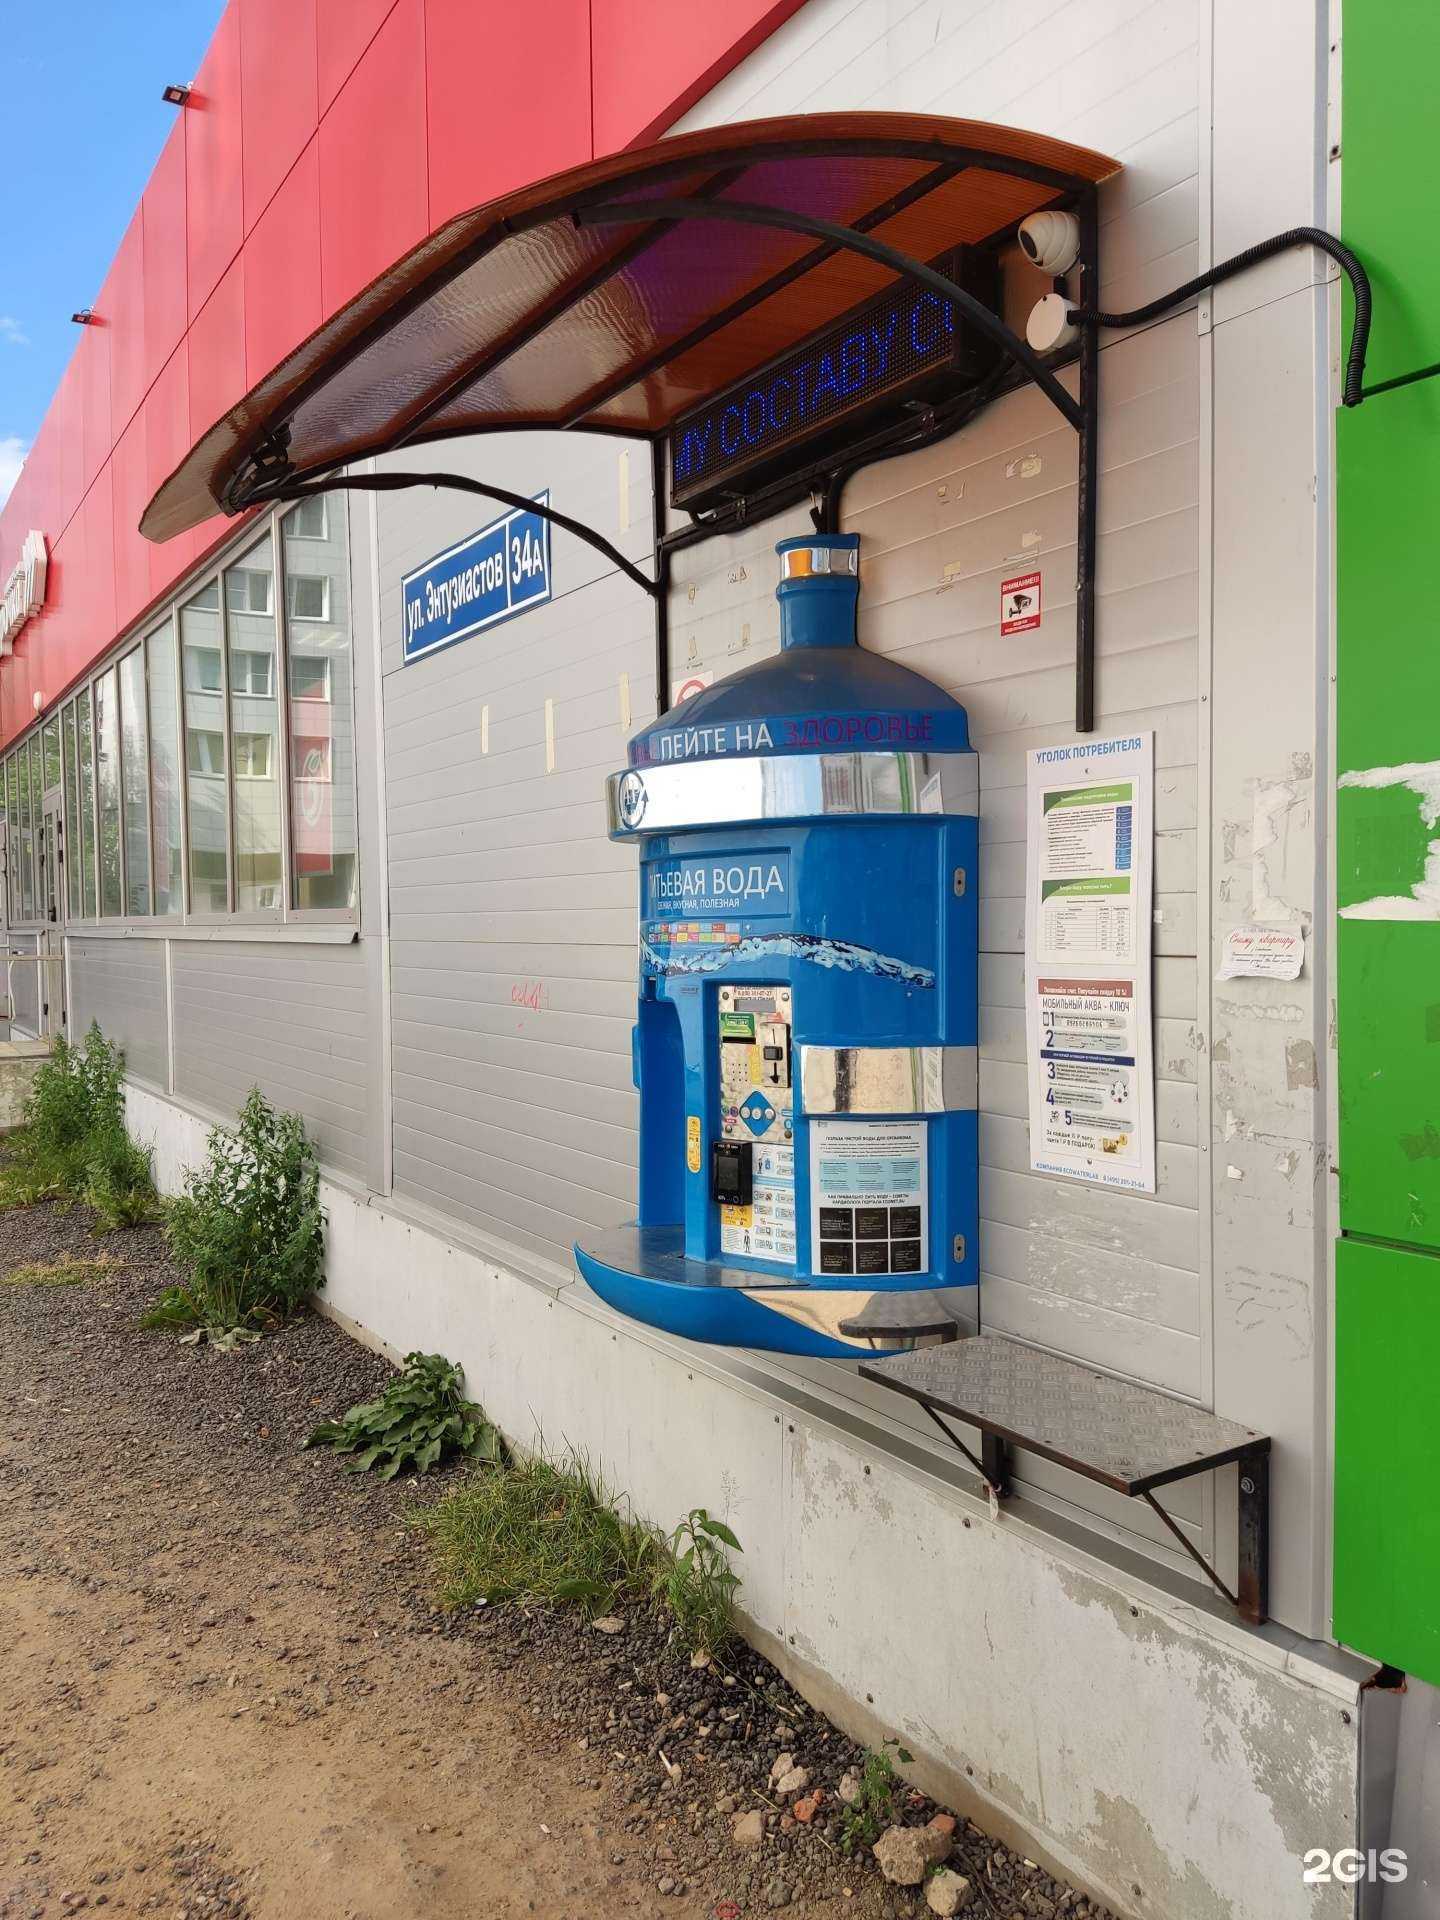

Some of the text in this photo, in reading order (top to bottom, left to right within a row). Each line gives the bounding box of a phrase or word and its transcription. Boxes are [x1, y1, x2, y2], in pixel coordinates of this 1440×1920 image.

[720, 311, 897, 457] СОСТАВУ
[407, 528, 544, 644] ул. Энтузиастов 34А
[660, 726, 727, 761] ПЕЙТЕ
[735, 722, 774, 751] НА
[783, 714, 935, 747] ЗДОРОВЬЕ
[1035, 737, 1142, 764] УГОЛОК ПОТРЕБИТЕЛЯ
[712, 864, 785, 900] ВОДА
[700, 898, 740, 909] ПОЛЕЗНАЯ
[1042, 997, 1083, 1009] МОБИЛЬНЫЙ
[1084, 1001, 1102, 1011] АКВА
[1109, 1001, 1130, 1012] КЛЮЧ
[1050, 1012, 1055, 1026] 1
[1045, 1030, 1054, 1047] 2
[1047, 1061, 1056, 1079] 3
[1045, 1087, 1055, 1105] 4
[1064, 1110, 1072, 1125] 5
